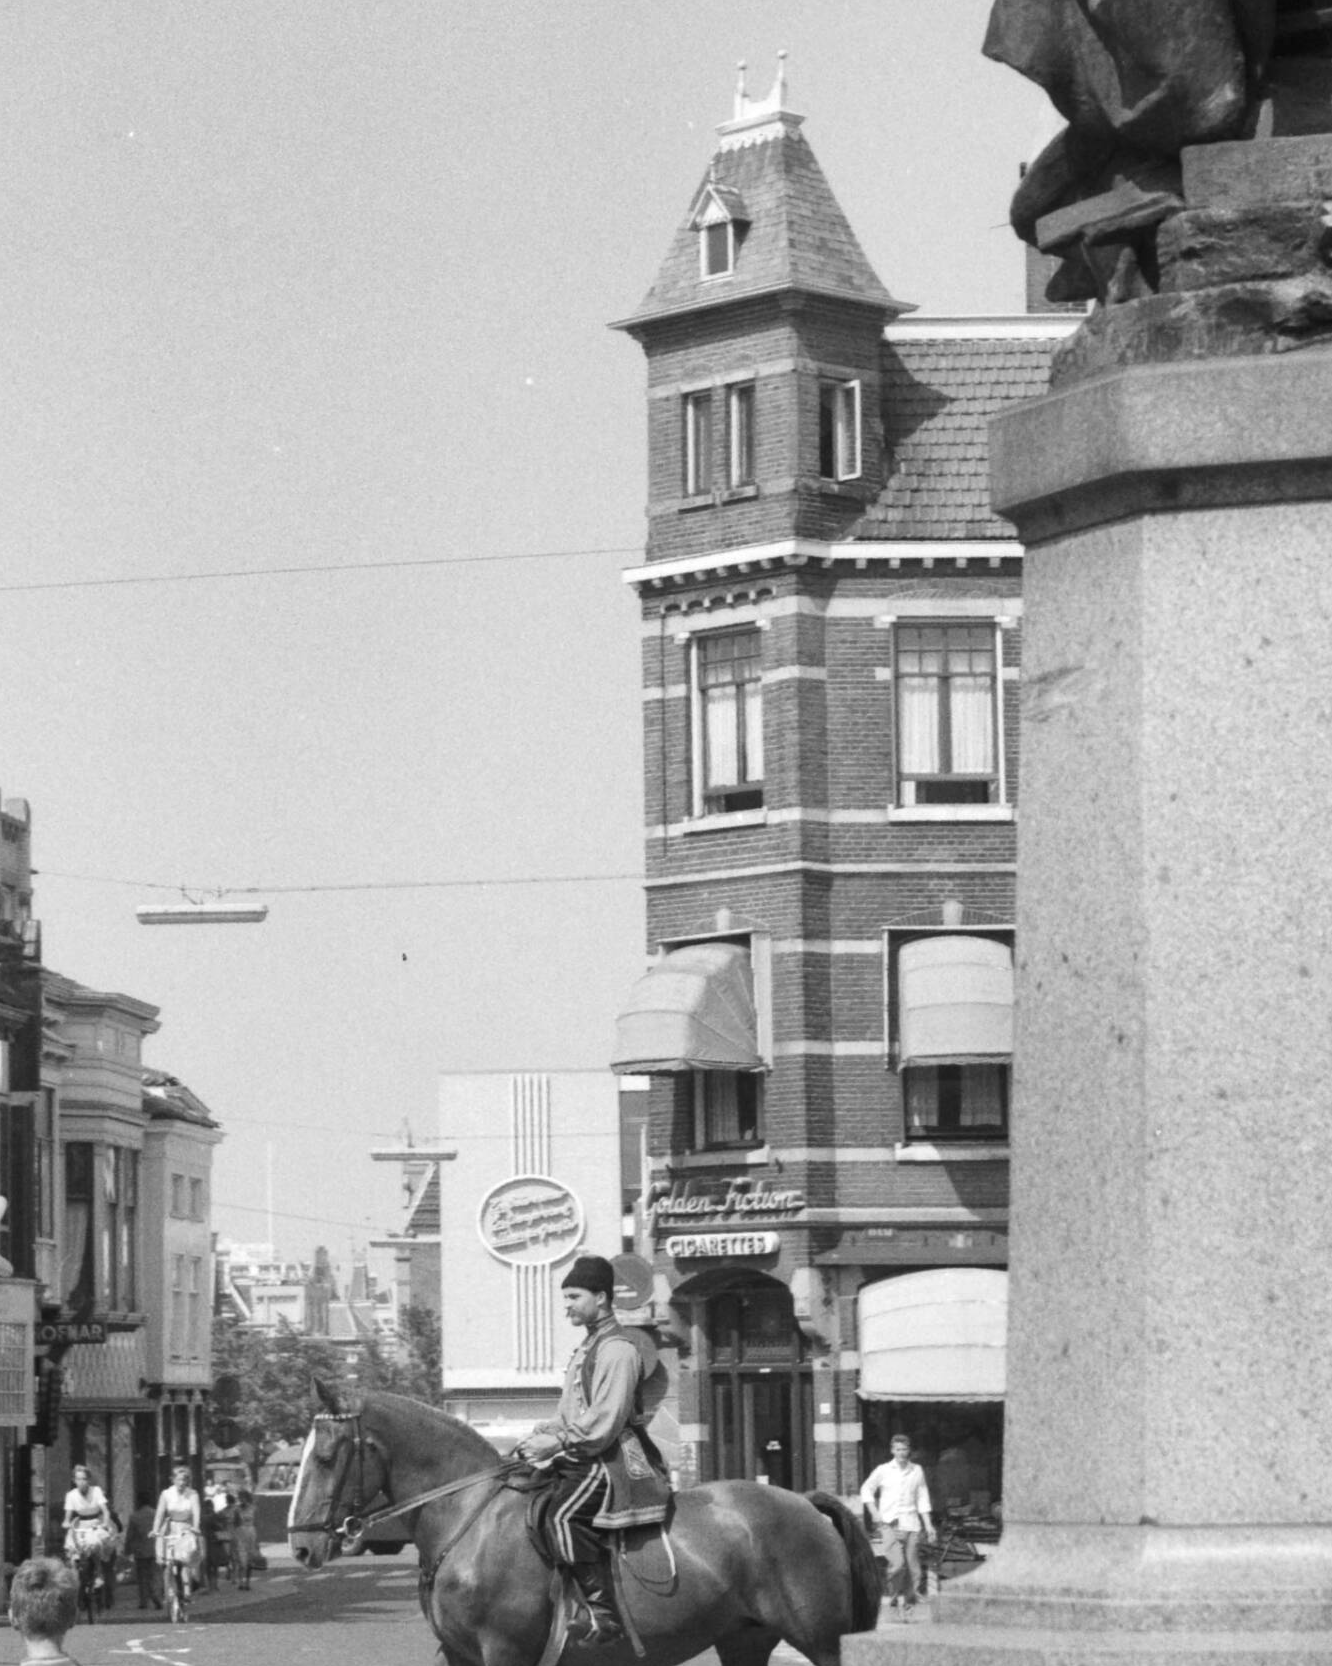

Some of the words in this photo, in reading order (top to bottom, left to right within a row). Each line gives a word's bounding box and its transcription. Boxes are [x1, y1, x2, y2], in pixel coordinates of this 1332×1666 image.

[641, 1181, 716, 1216] Golden
[720, 1177, 805, 1211] Fiction
[670, 1235, 766, 1257] CIGARETTES
